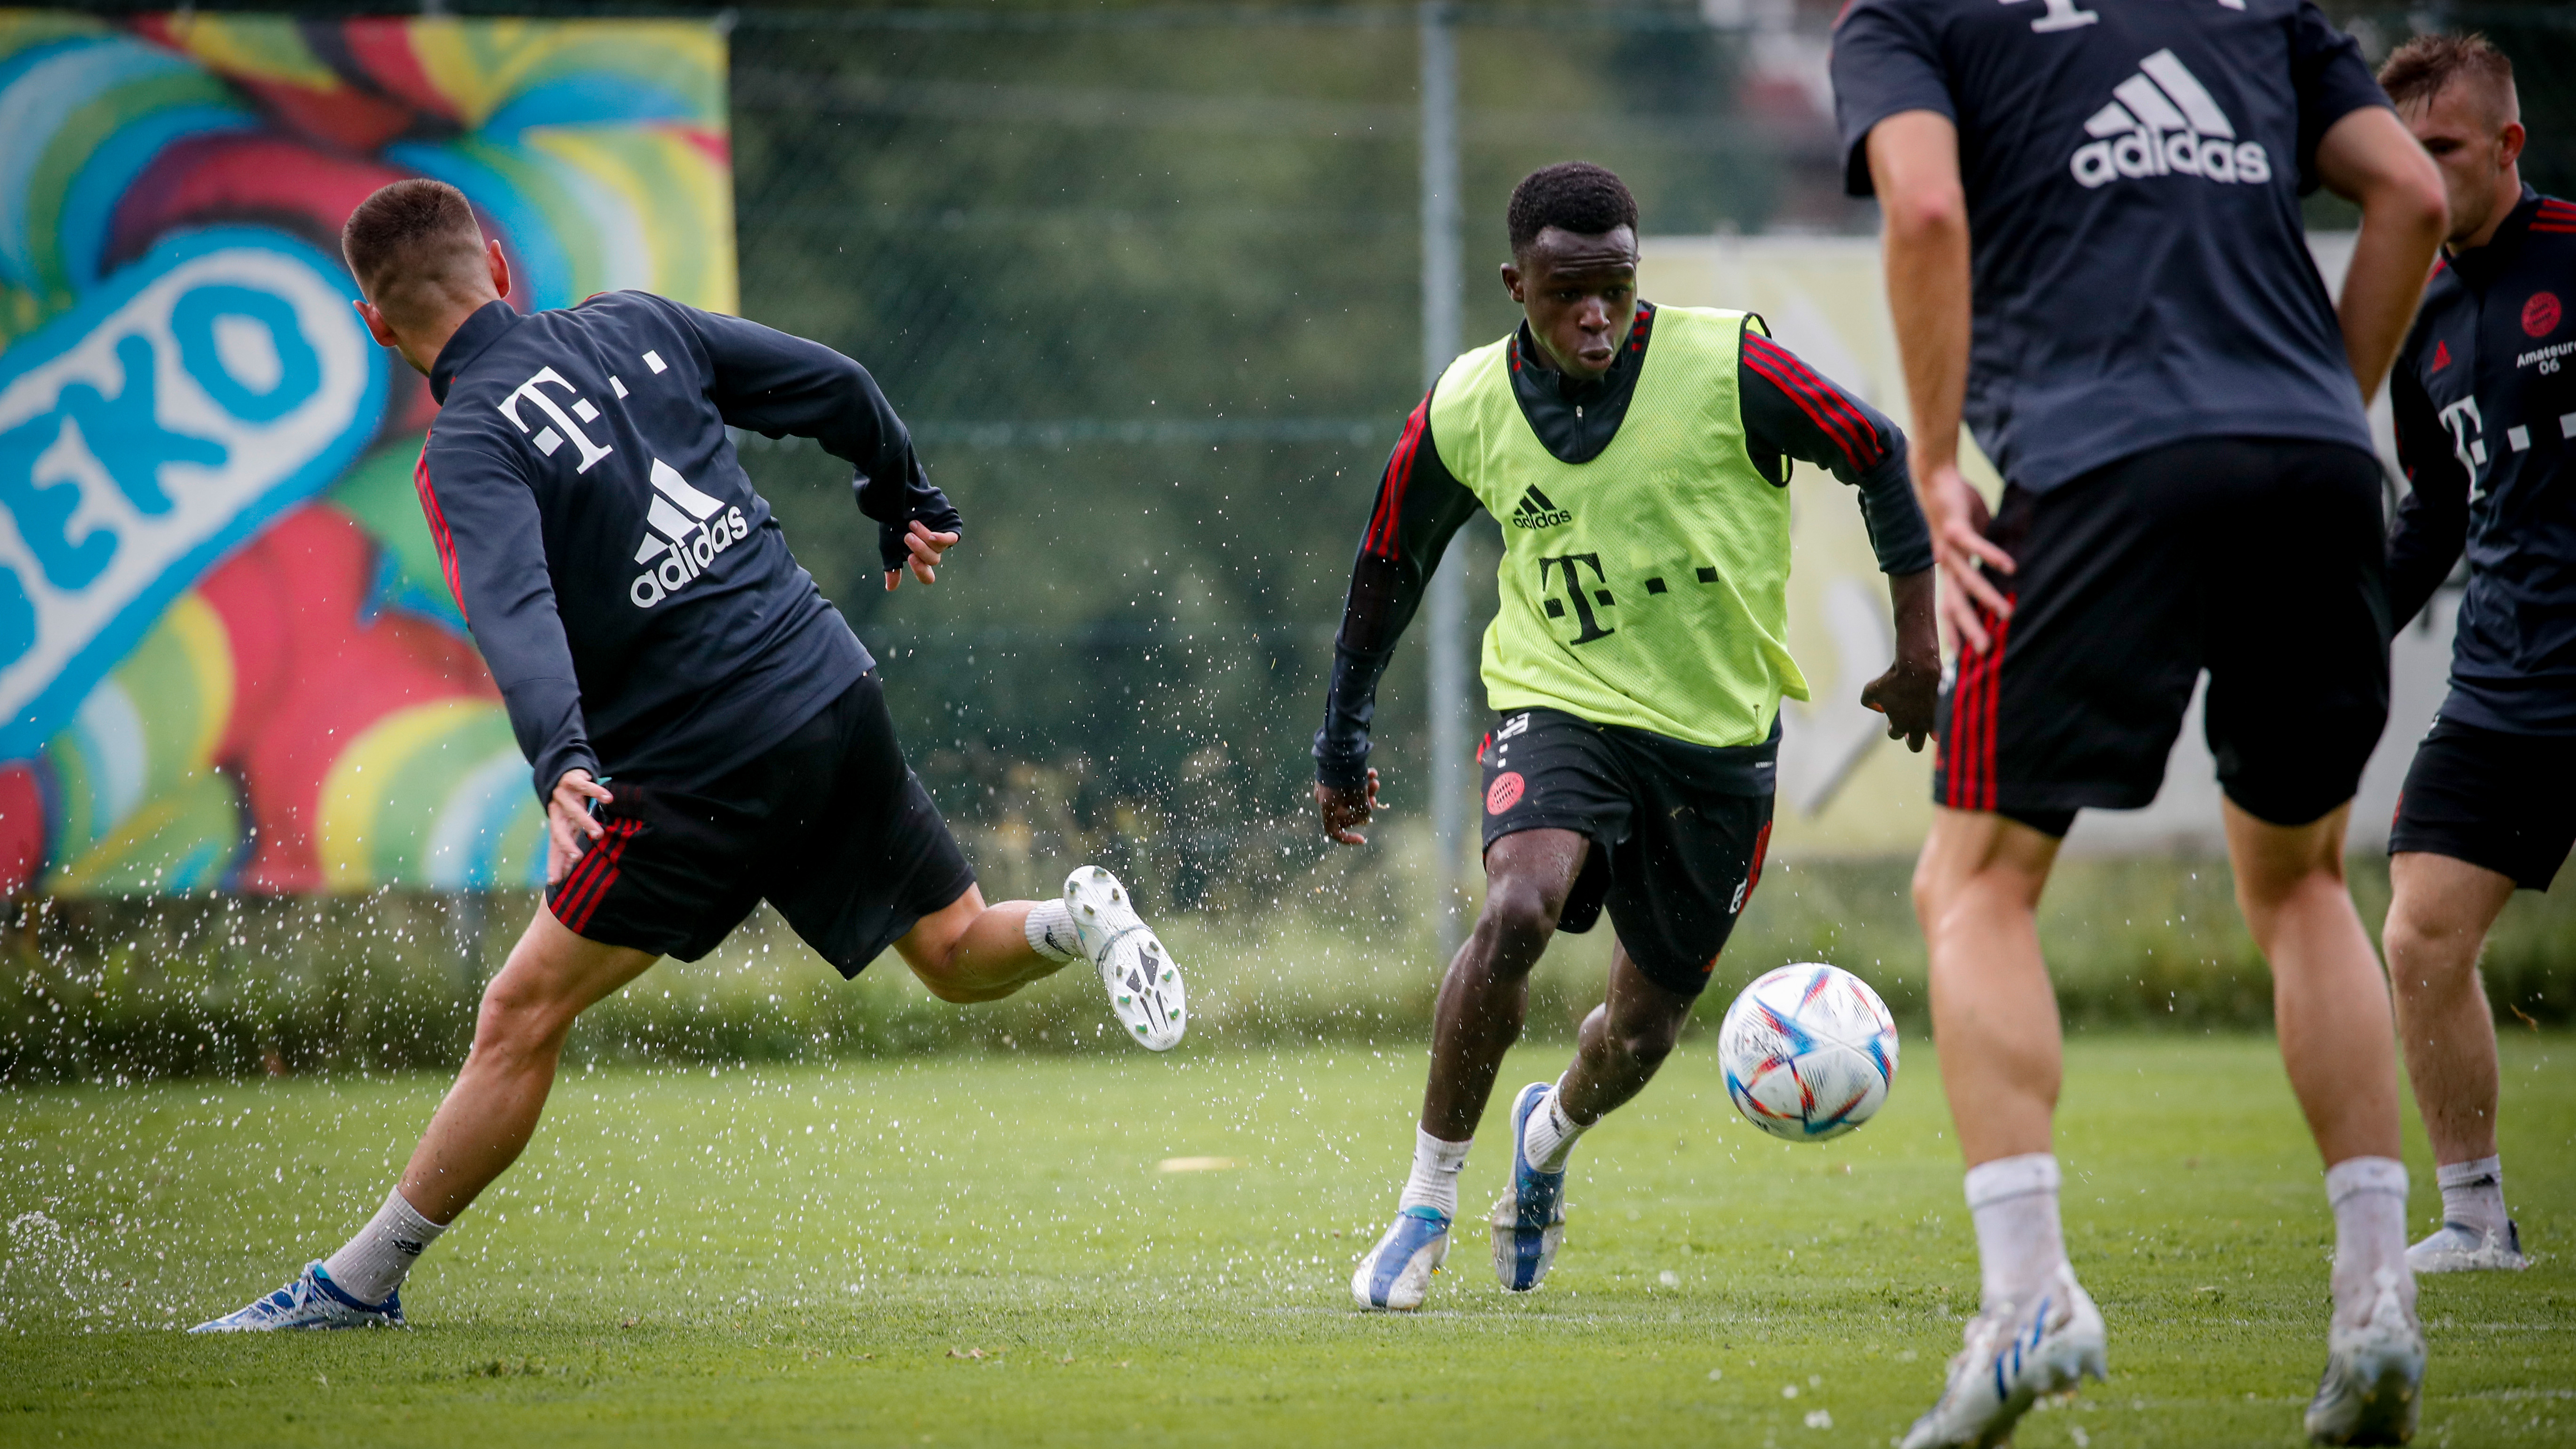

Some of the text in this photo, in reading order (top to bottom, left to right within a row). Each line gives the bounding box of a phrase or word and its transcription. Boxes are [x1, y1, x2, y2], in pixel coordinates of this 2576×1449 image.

[2070, 124, 2271, 189] adidas
[2516, 341, 2576, 368] Amateur
[2539, 358, 2560, 376] 06
[0, 285, 324, 658] EKO
[1513, 509, 1572, 530] adidas
[630, 506, 749, 608] adidas
